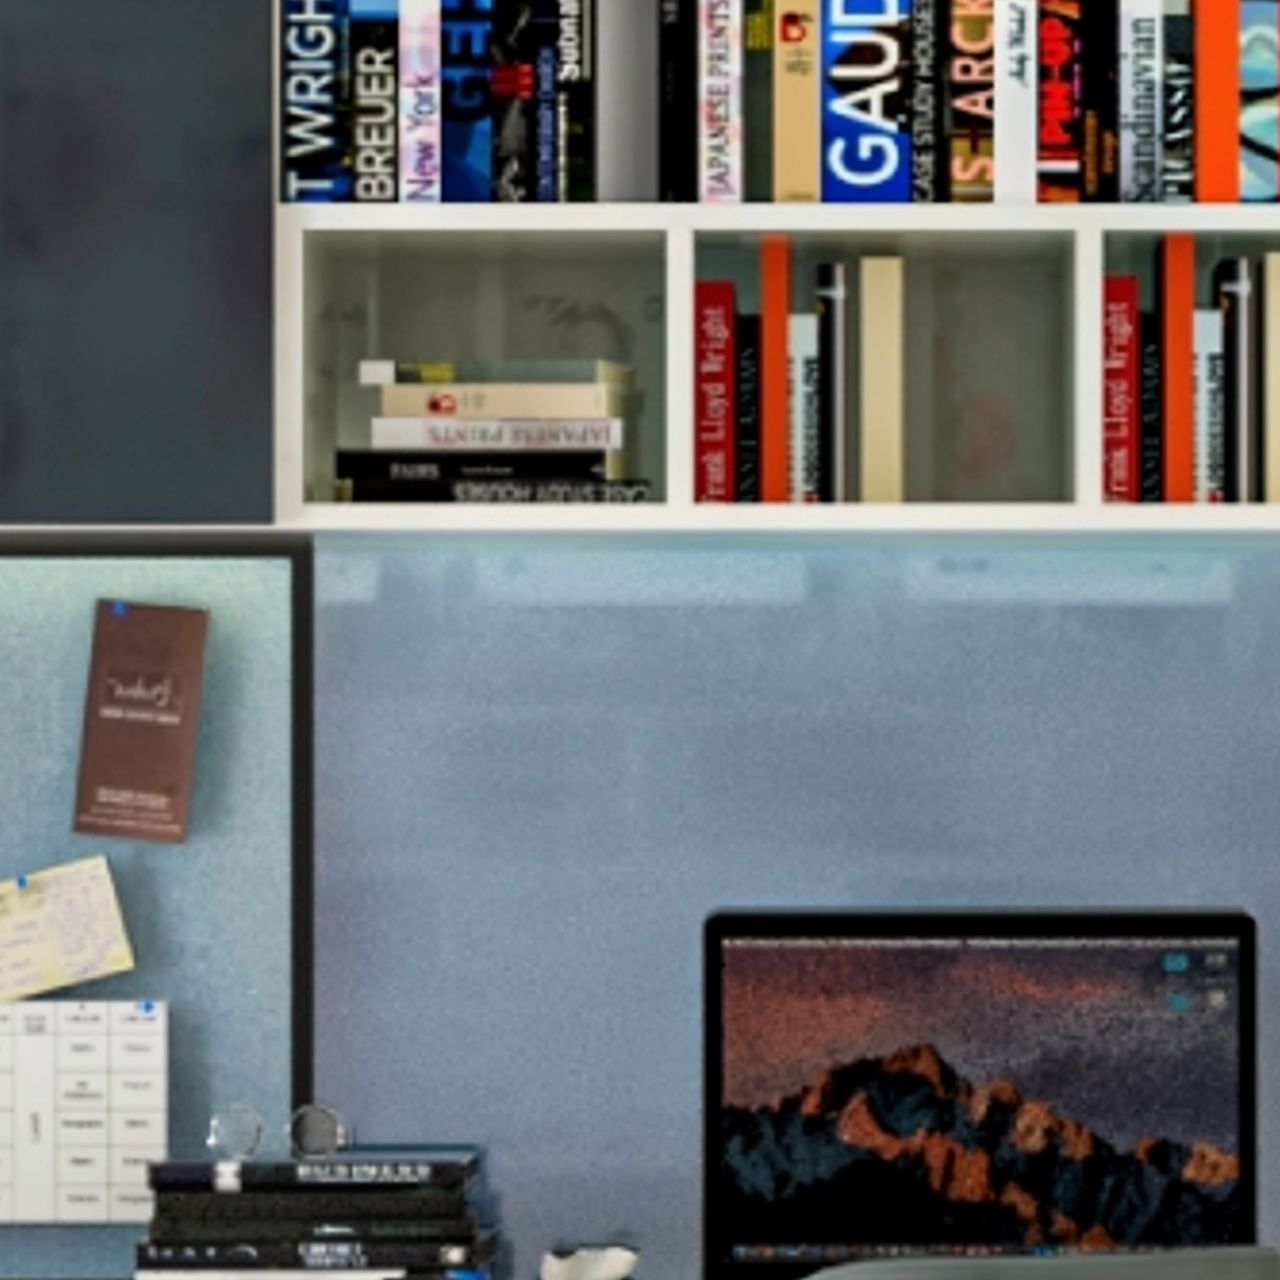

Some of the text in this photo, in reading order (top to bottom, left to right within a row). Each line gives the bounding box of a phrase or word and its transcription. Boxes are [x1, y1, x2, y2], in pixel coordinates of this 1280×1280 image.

[911, 82, 936, 146] STUDY
[1040, 17, 1073, 145] PIN-UP
[1120, 17, 1156, 202] Scandinavian
[354, 47, 396, 201] BREUER
[405, 74, 439, 202] New York
[706, 82, 737, 197] JAPANESE
[286, 170, 335, 202] T
[911, 151, 936, 202] CASE
[701, 306, 730, 374] Wright
[1105, 302, 1133, 370] Wright
[701, 383, 728, 442] Lloyd
[1105, 380, 1133, 438] Lloyd
